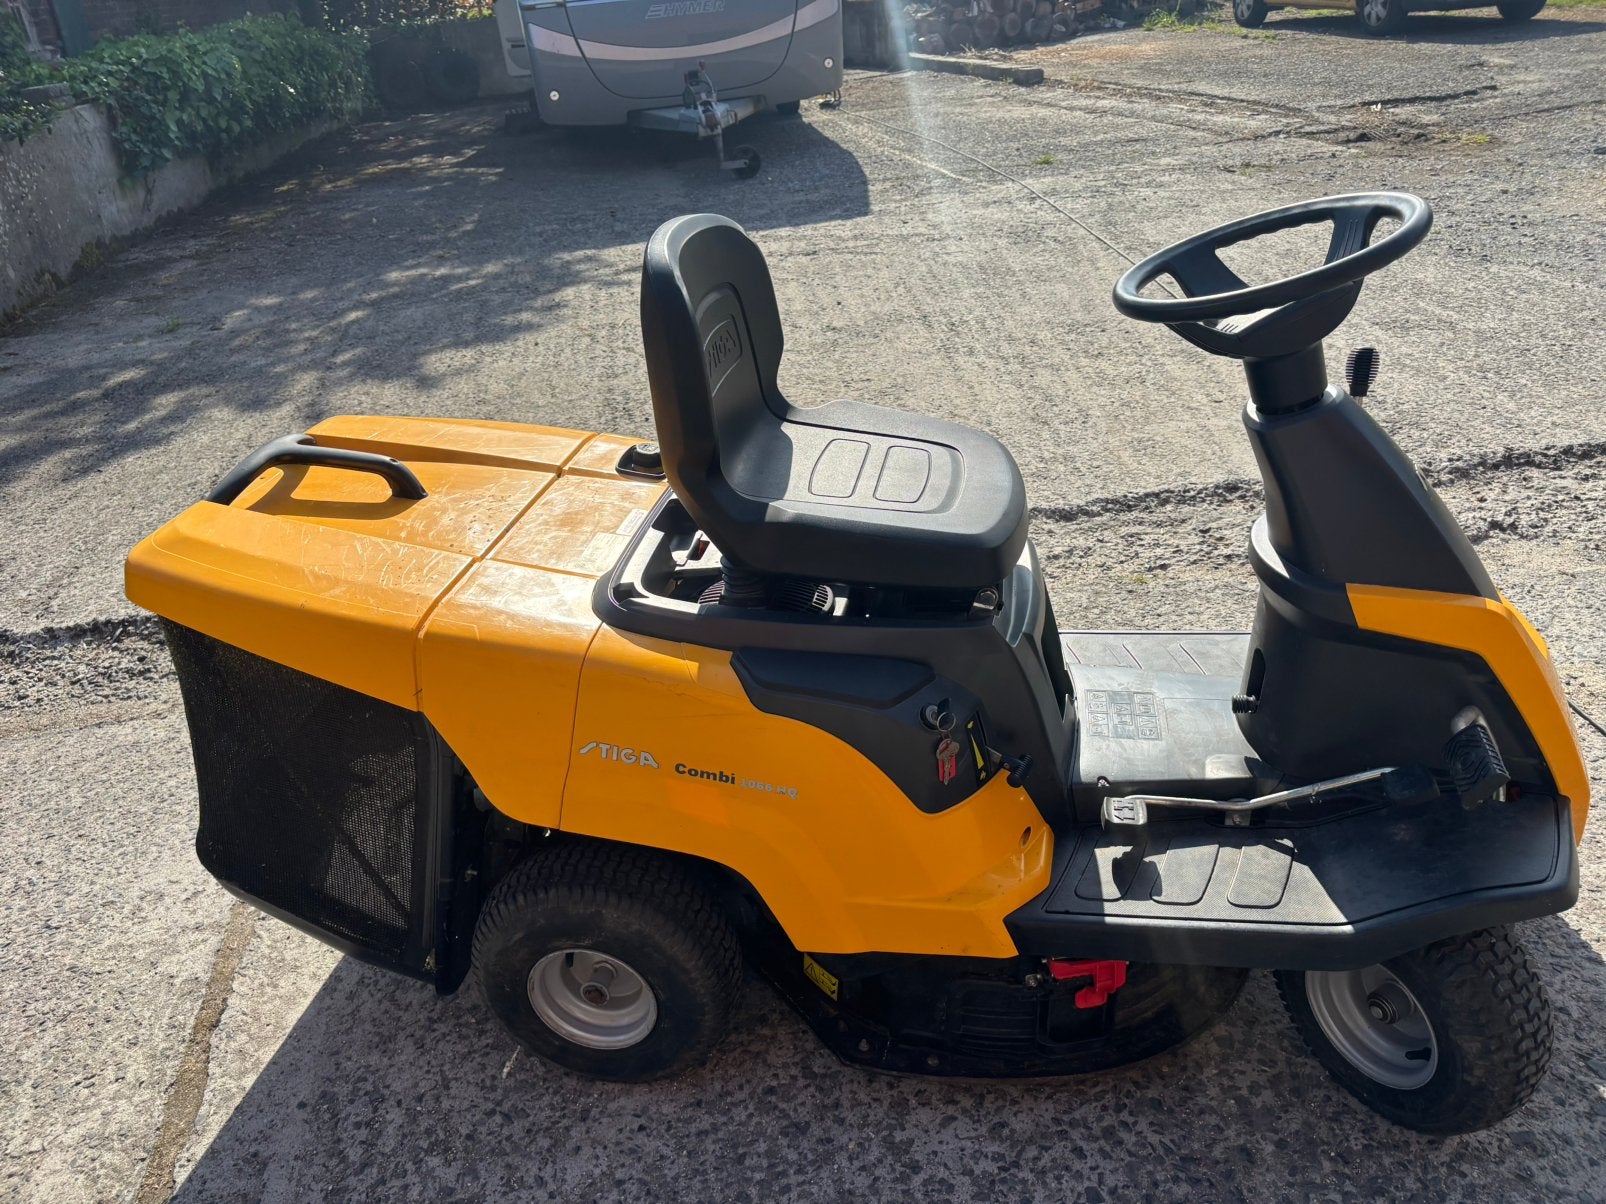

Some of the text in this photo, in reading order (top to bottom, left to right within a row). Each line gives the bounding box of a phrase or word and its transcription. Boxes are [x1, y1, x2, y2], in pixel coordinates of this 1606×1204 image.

[660, 0, 727, 17] HYMER
[579, 741, 799, 801] STIGA Combi 1066 HQ
